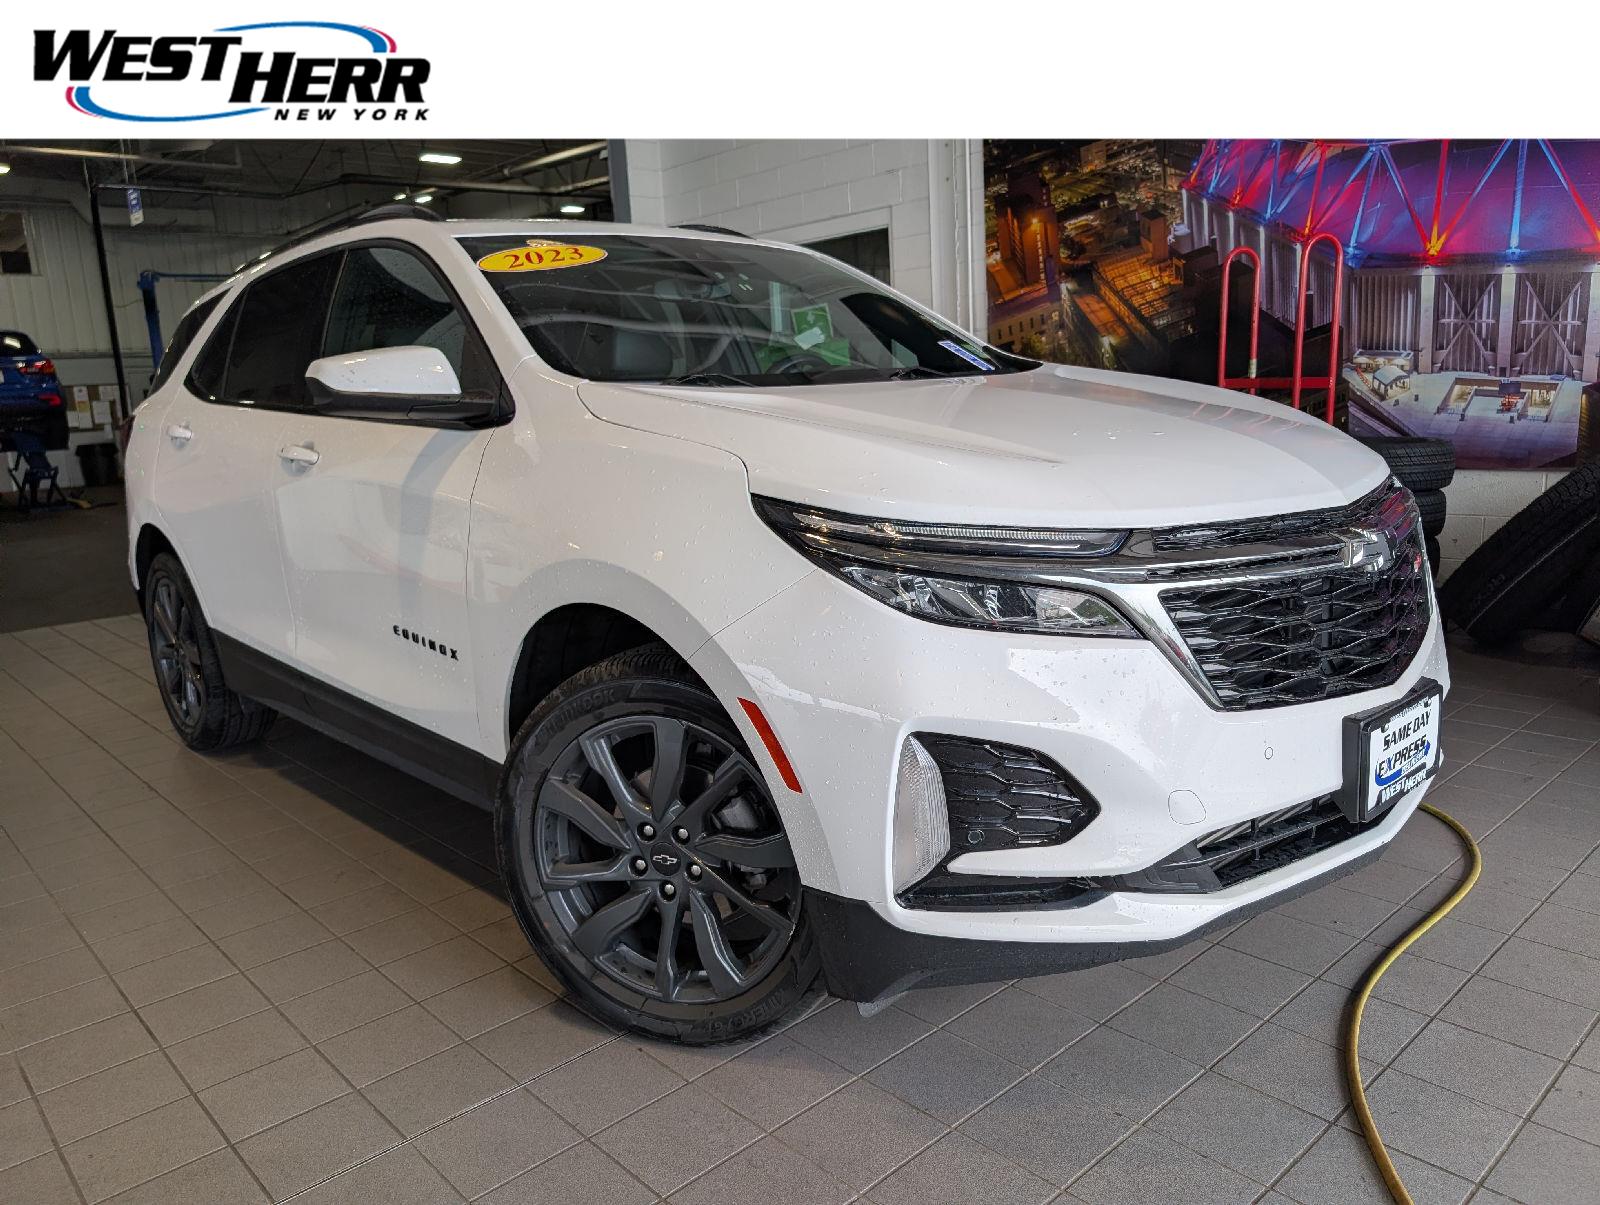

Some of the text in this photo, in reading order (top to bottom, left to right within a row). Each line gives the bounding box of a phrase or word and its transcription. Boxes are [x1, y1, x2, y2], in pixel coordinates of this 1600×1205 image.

[503, 247, 584, 269] 2023
[392, 624, 459, 661] EQUINOX
[1382, 725, 1412, 752] SAME
[1412, 708, 1432, 734] DAY
[1378, 734, 1427, 779] EXPRESS
